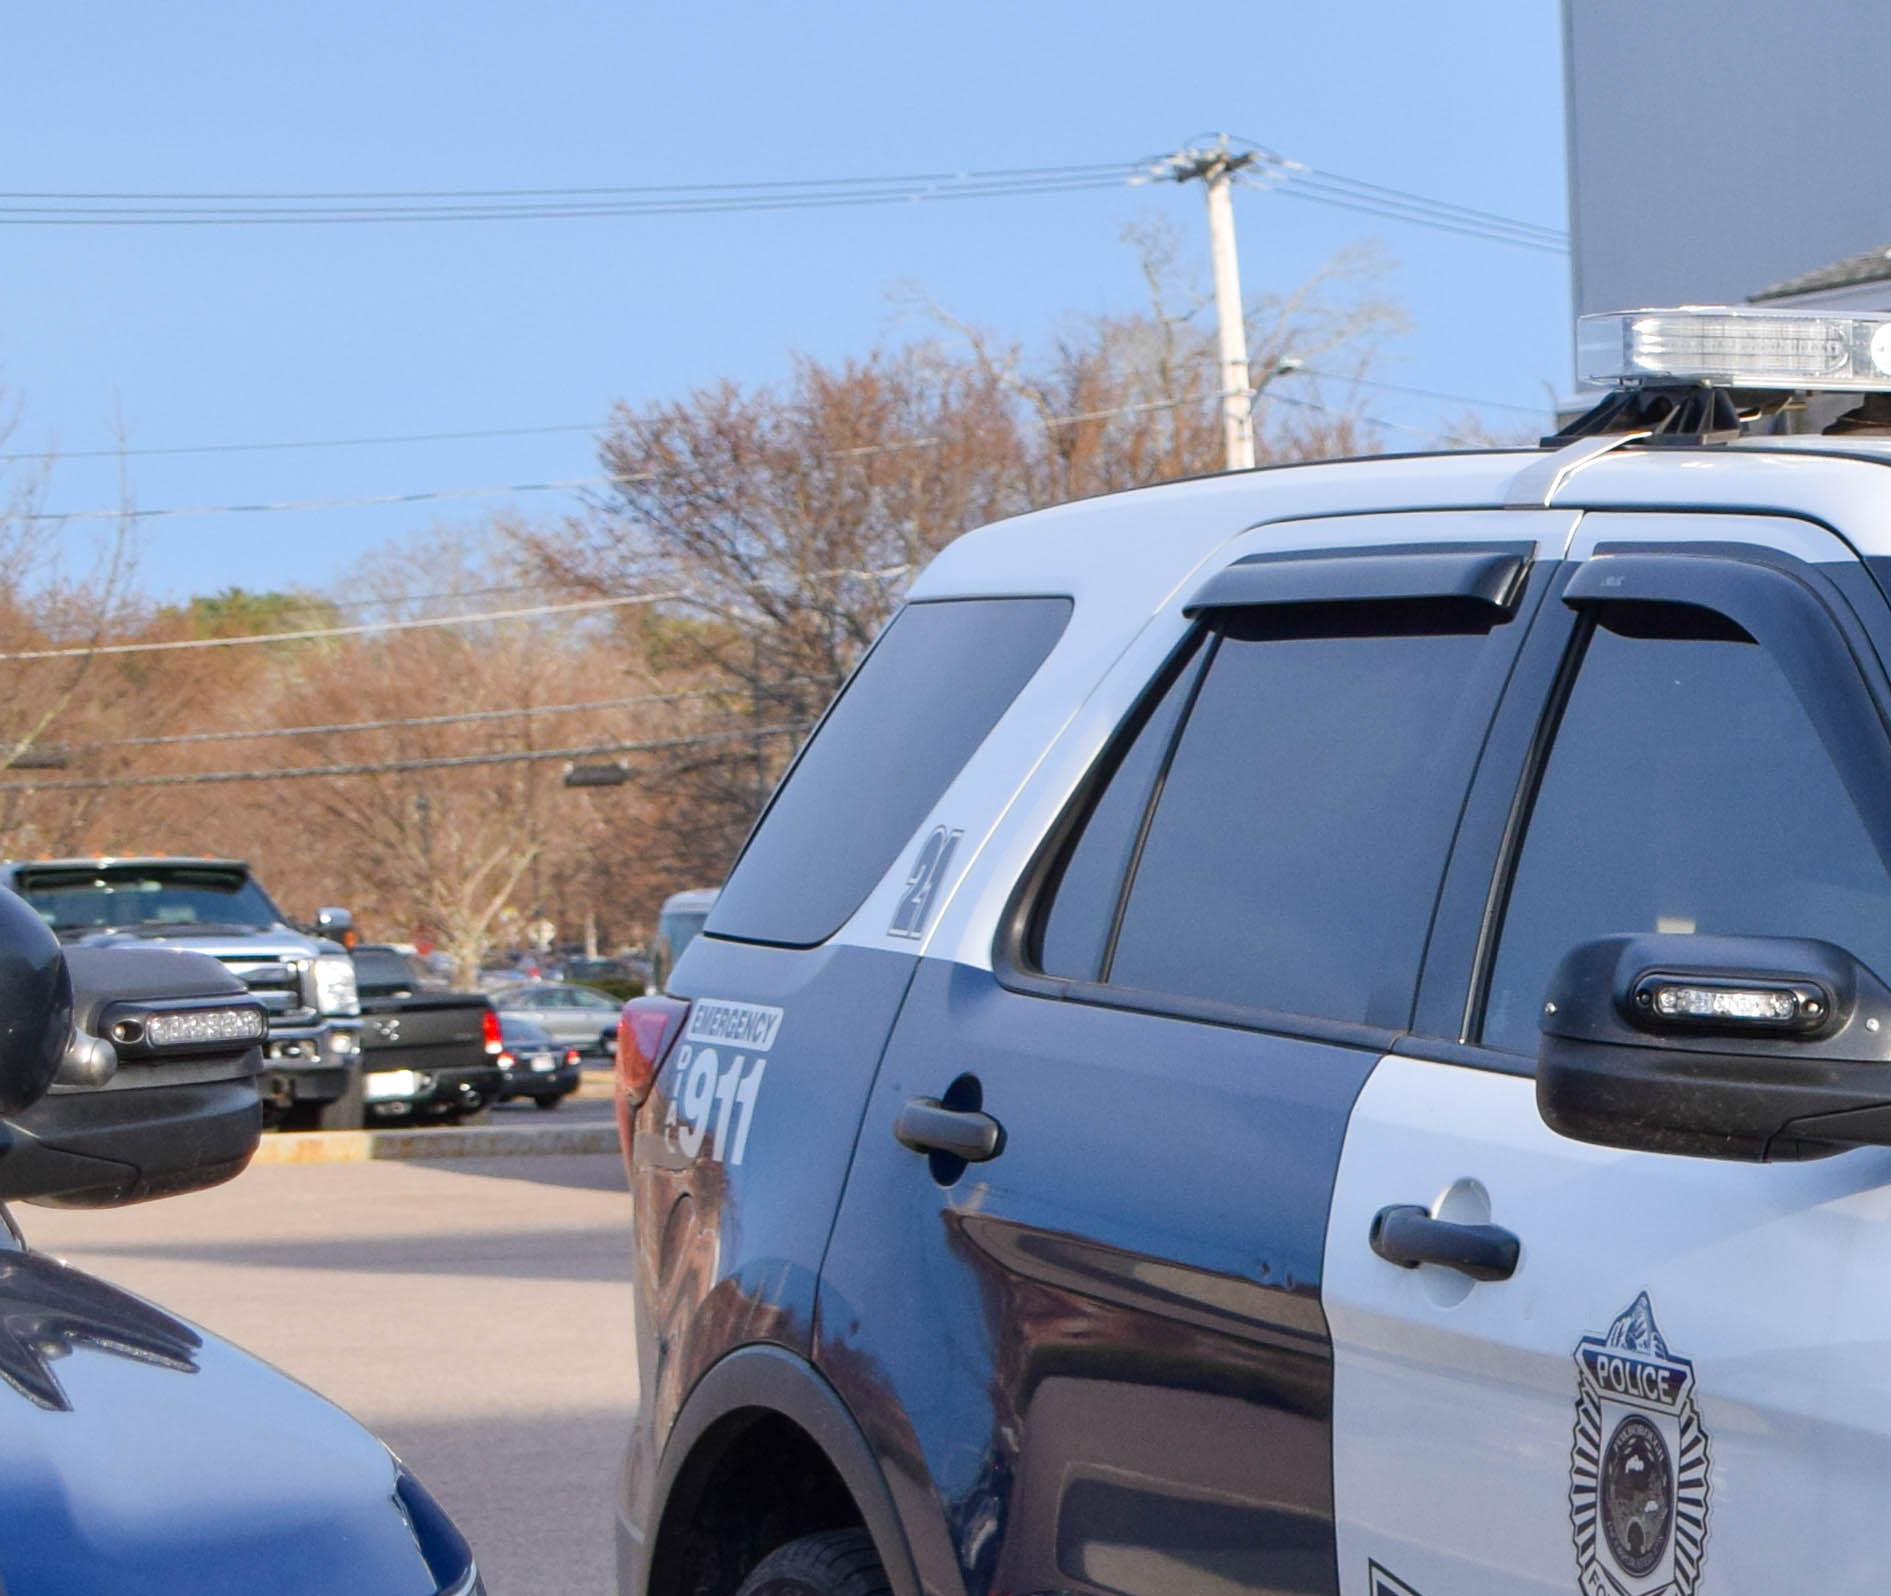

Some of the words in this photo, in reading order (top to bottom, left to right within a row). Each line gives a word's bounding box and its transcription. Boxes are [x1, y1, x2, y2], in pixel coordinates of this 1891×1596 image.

[690, 1004, 778, 1044] EMERGENCY
[679, 1048, 767, 1166] 911
[1597, 1354, 1674, 1405] POLICE
